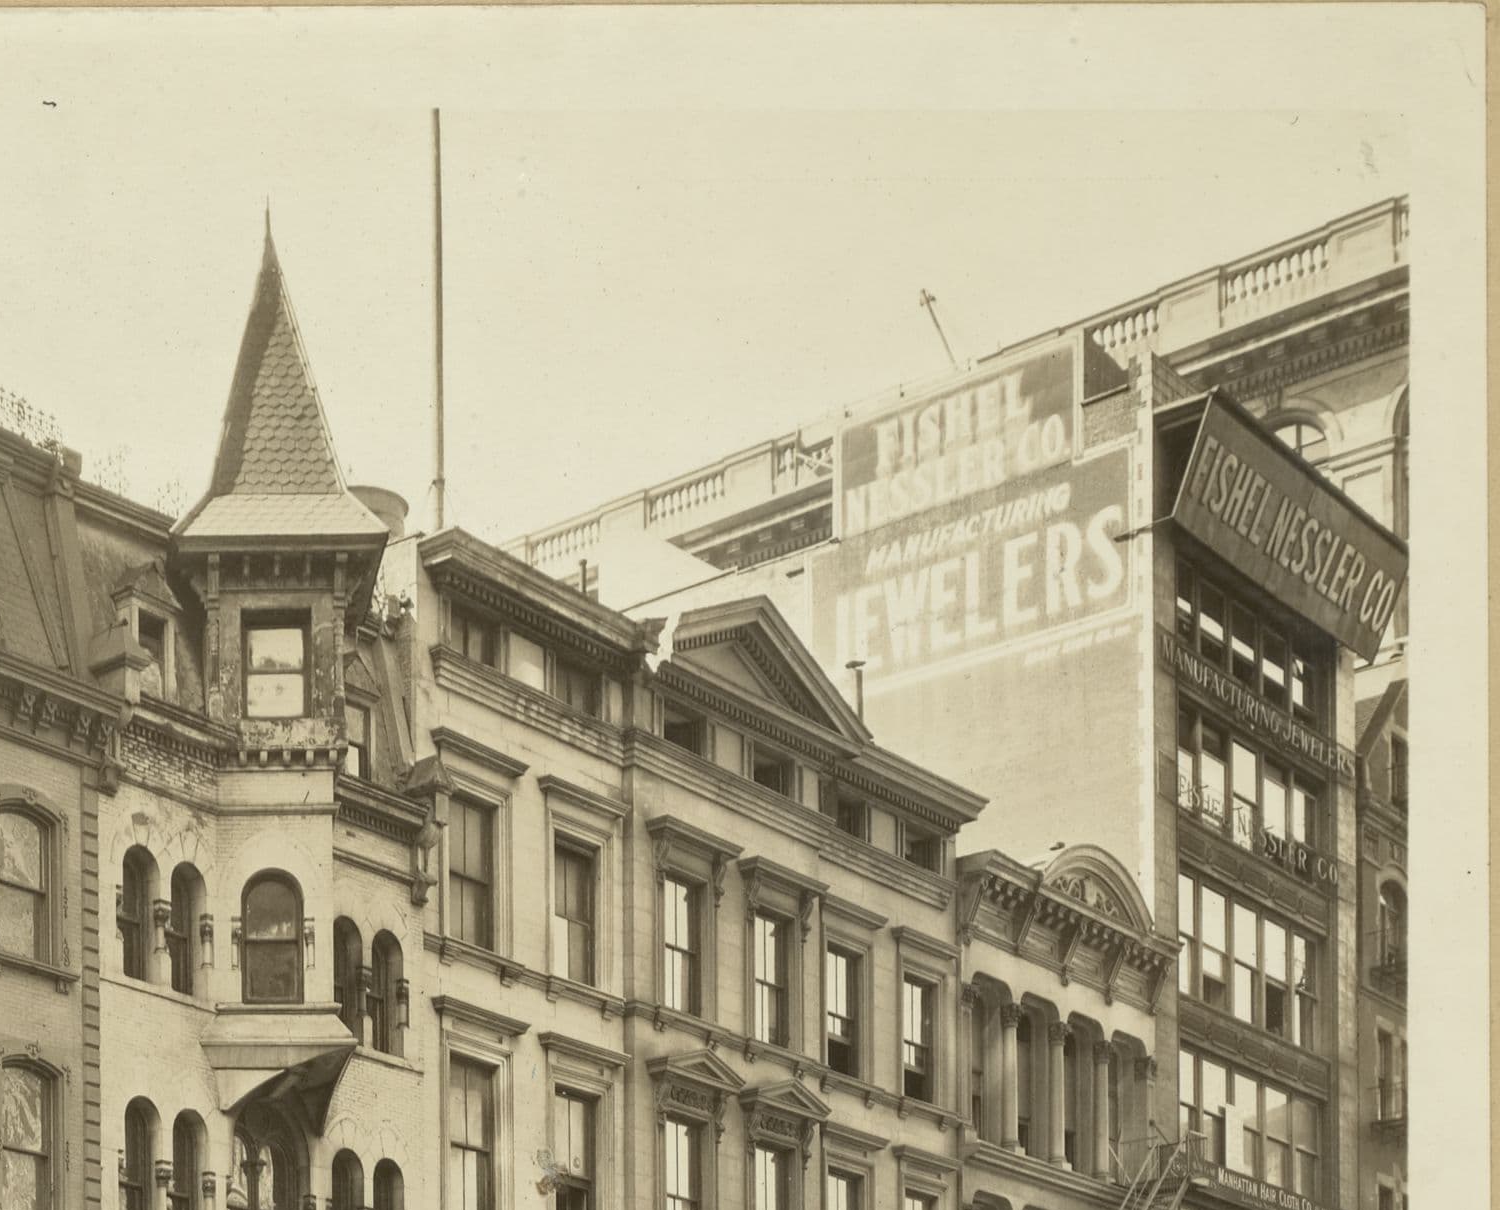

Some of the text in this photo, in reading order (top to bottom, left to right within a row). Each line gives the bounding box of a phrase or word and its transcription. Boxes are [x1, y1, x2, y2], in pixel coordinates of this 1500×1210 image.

[875, 368, 1032, 481] FISHEL
[844, 438, 1008, 539] NESSLER
[864, 481, 1073, 577] MANUFACTURING
[1190, 434, 1273, 546] FISHEL
[1264, 495, 1367, 613] NESSLER
[1160, 633, 1280, 735] MANUFACTURING
[1282, 718, 1357, 778] JEWELERS
[1218, 1166, 1259, 1198] MANHATTAN
[1260, 1183, 1278, 1204] HAIR
[1278, 1189, 1301, 1210] CLOTH
